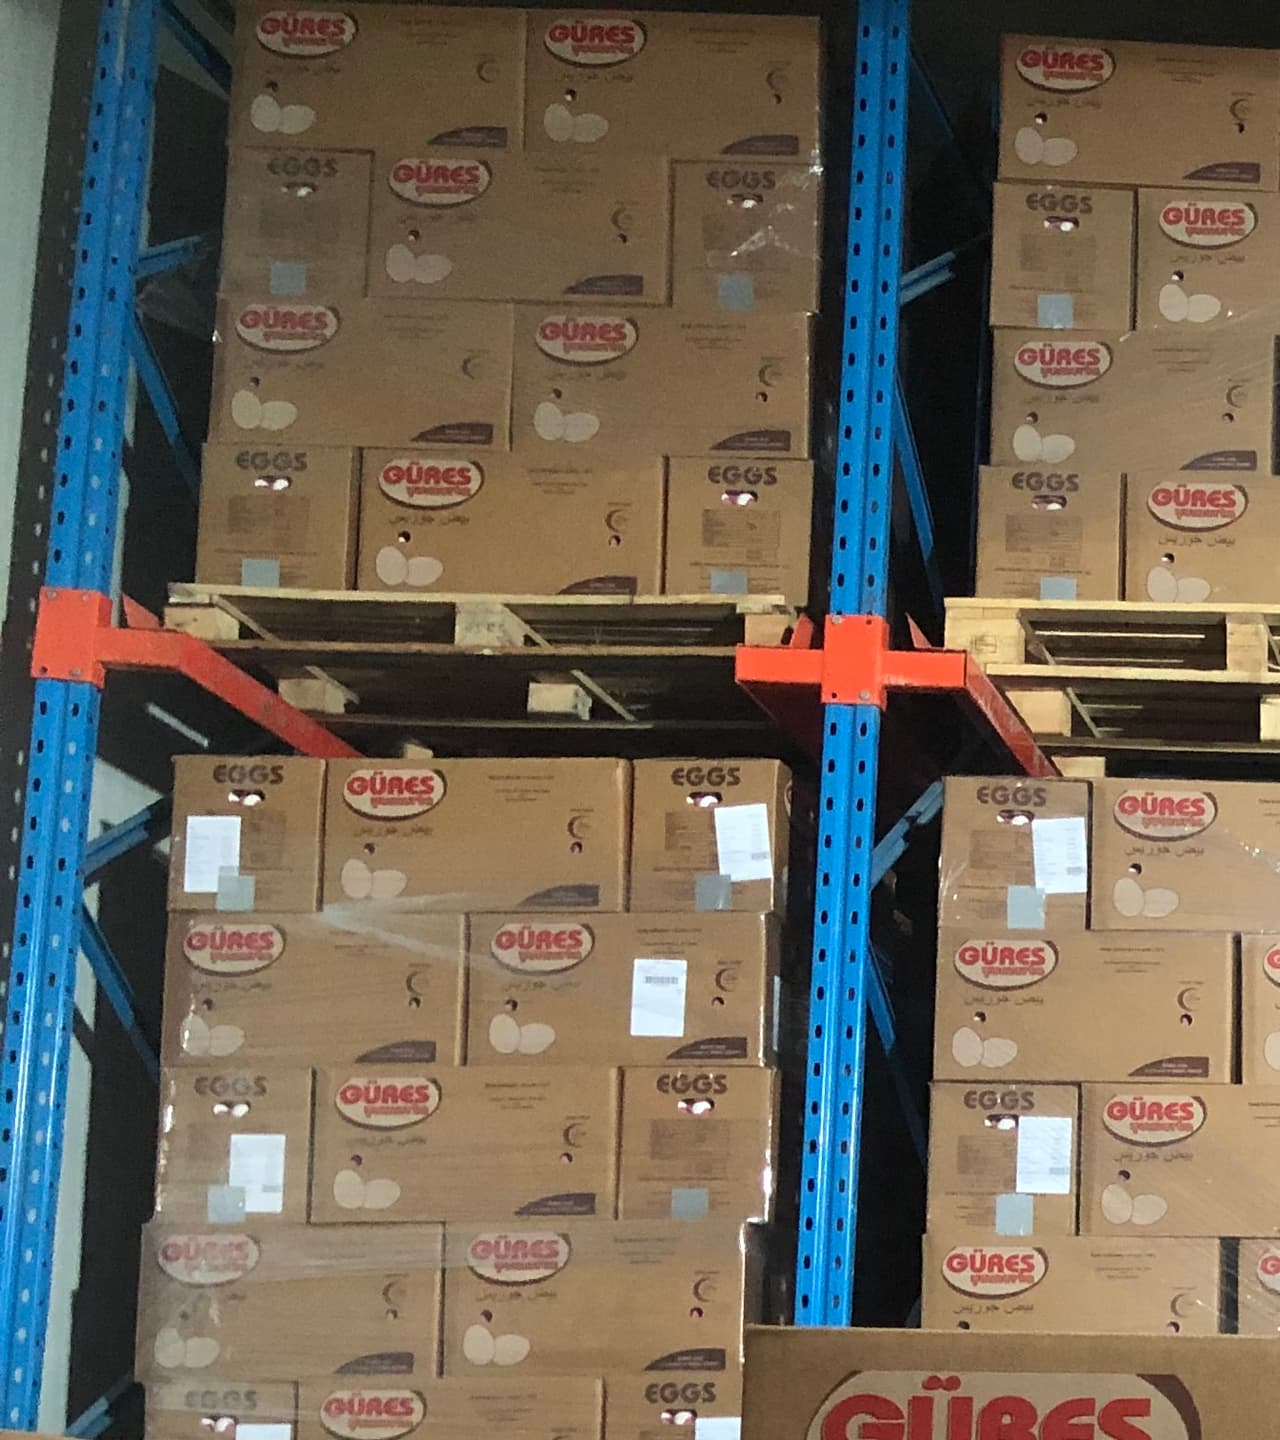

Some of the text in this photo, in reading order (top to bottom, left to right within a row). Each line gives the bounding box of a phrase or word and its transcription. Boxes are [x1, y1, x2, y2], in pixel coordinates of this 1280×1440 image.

[1021, 45, 1105, 73] GÜRES
[1026, 192, 1092, 214] EGGS
[1162, 201, 1246, 229] GÜRES
[538, 316, 628, 343] GÜRES
[235, 450, 307, 472] EGGS
[382, 460, 471, 487] GÜRES
[707, 464, 777, 487] EGGS
[1012, 472, 1078, 494] EGGS
[1153, 482, 1236, 511] GÜRES
[212, 766, 283, 786] EGGS
[347, 769, 436, 797] GÜRES
[671, 767, 741, 786] EGGS
[977, 786, 1046, 806] EGGS
[1117, 791, 1206, 819] GÜRES
[958, 941, 1047, 969] GÜRES
[339, 1078, 429, 1106] GÜRES
